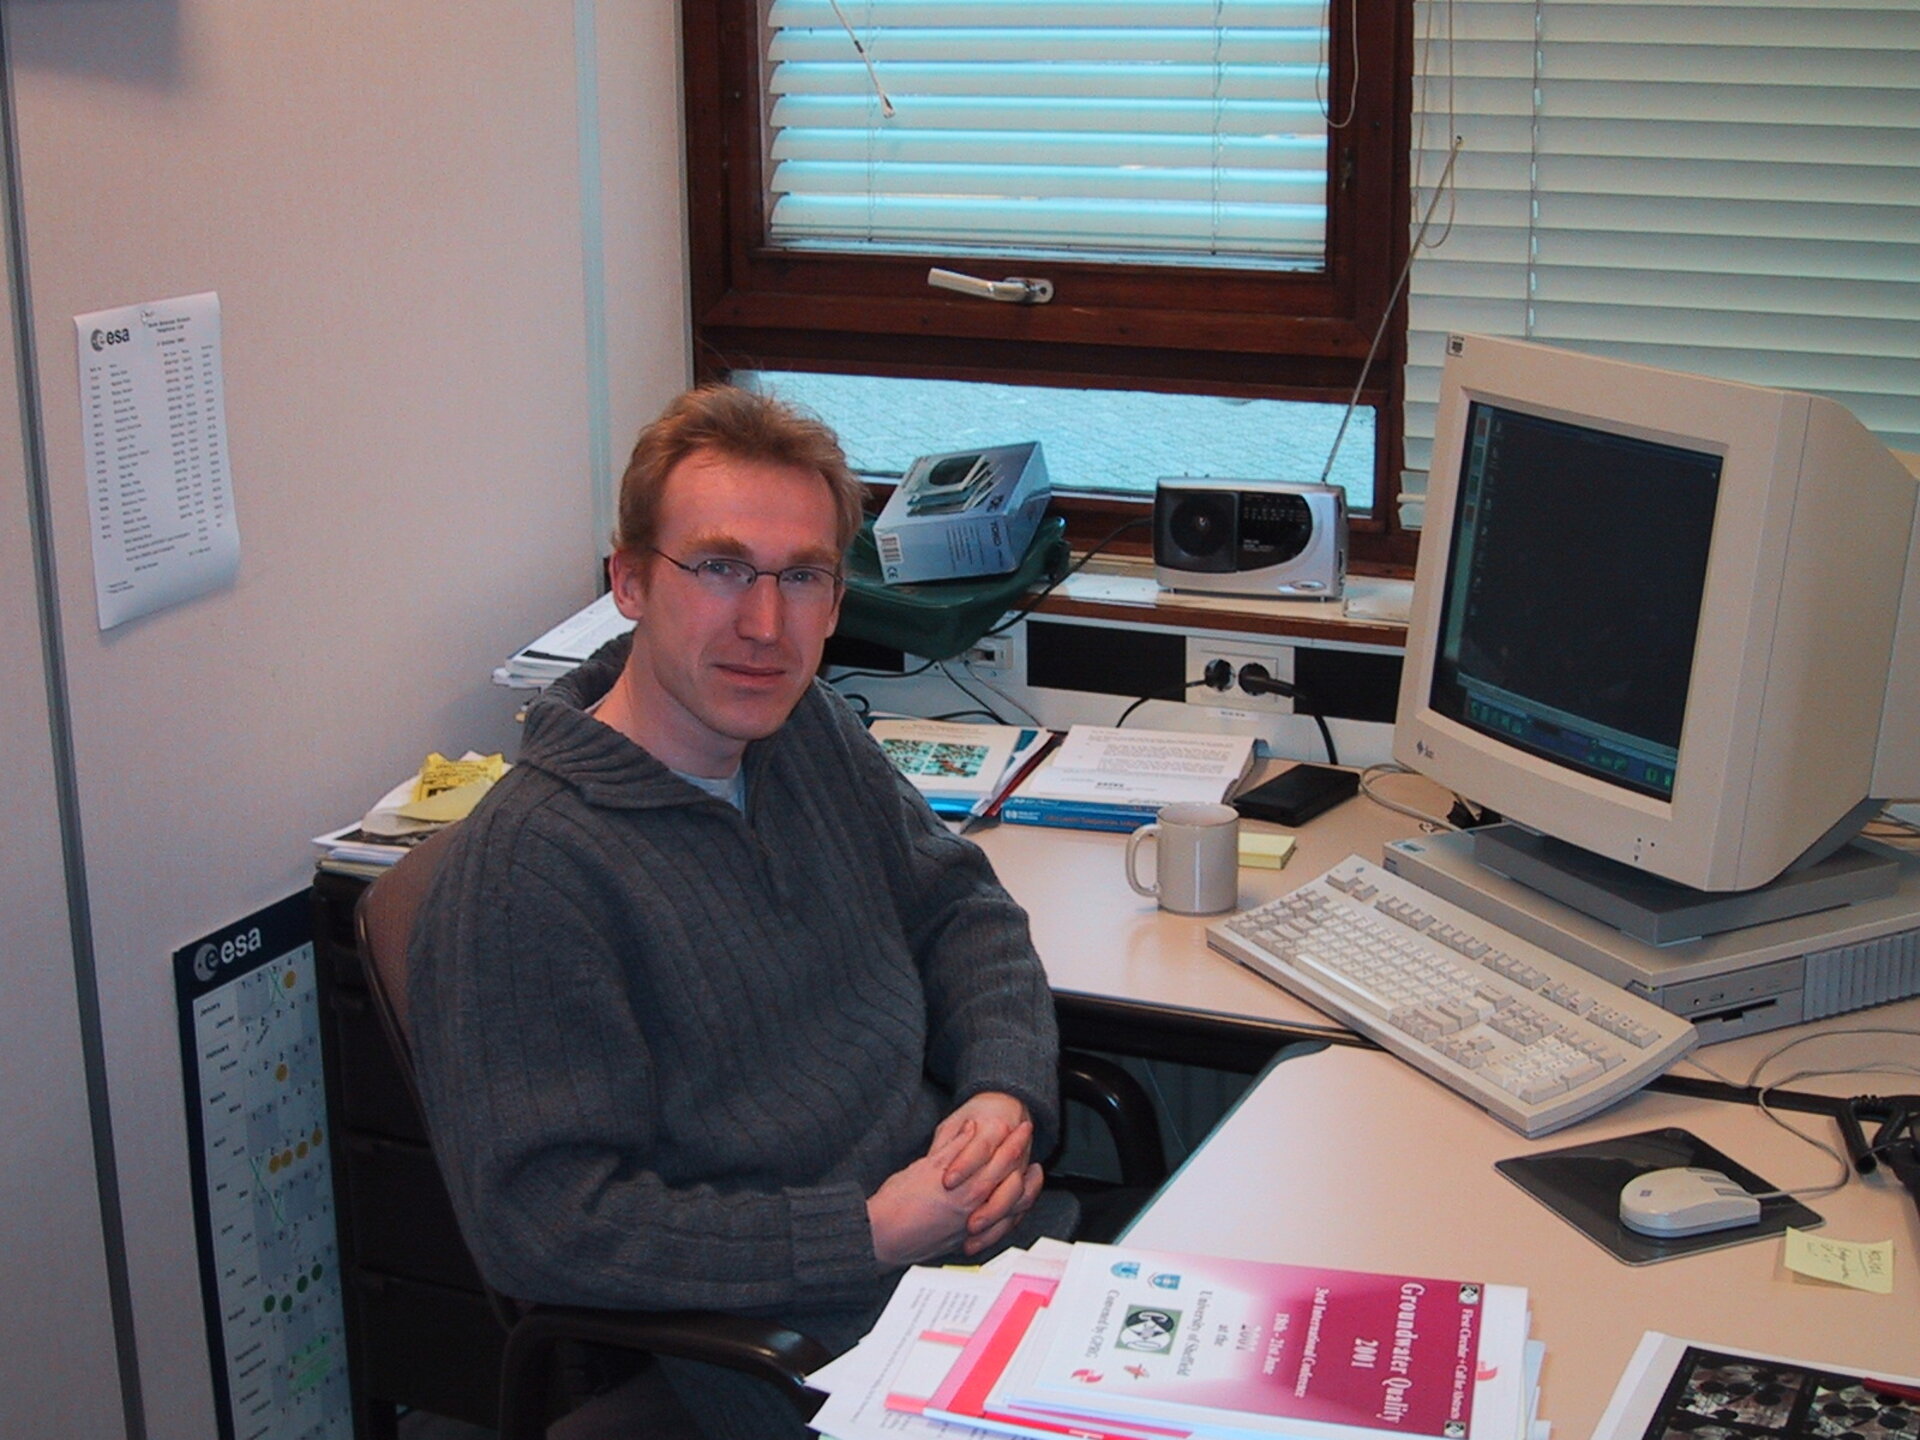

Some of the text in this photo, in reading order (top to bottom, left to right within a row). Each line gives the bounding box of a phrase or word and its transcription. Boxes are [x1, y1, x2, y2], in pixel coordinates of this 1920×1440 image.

[106, 328, 130, 345] esa
[221, 927, 261, 964] esa
[1098, 1289, 1120, 1325] Convened
[1459, 1308, 1472, 1329] First
[1091, 1326, 1108, 1334] by
[1177, 1290, 1213, 1377] University of Sheffield
[1214, 1324, 1229, 1347] at the
[1236, 1324, 1262, 1352] 2001
[1294, 1287, 1329, 1398] 3rd International Conference
[1457, 1330, 1470, 1357] Circular
[1263, 1355, 1279, 1375] June
[1350, 1338, 1379, 1368] 2001
[1376, 1283, 1425, 1422] Groundwater Quality
[1454, 1379, 1465, 1390] for
[1455, 1365, 1468, 1379] Call
[1451, 1390, 1465, 1420] Abstracts
